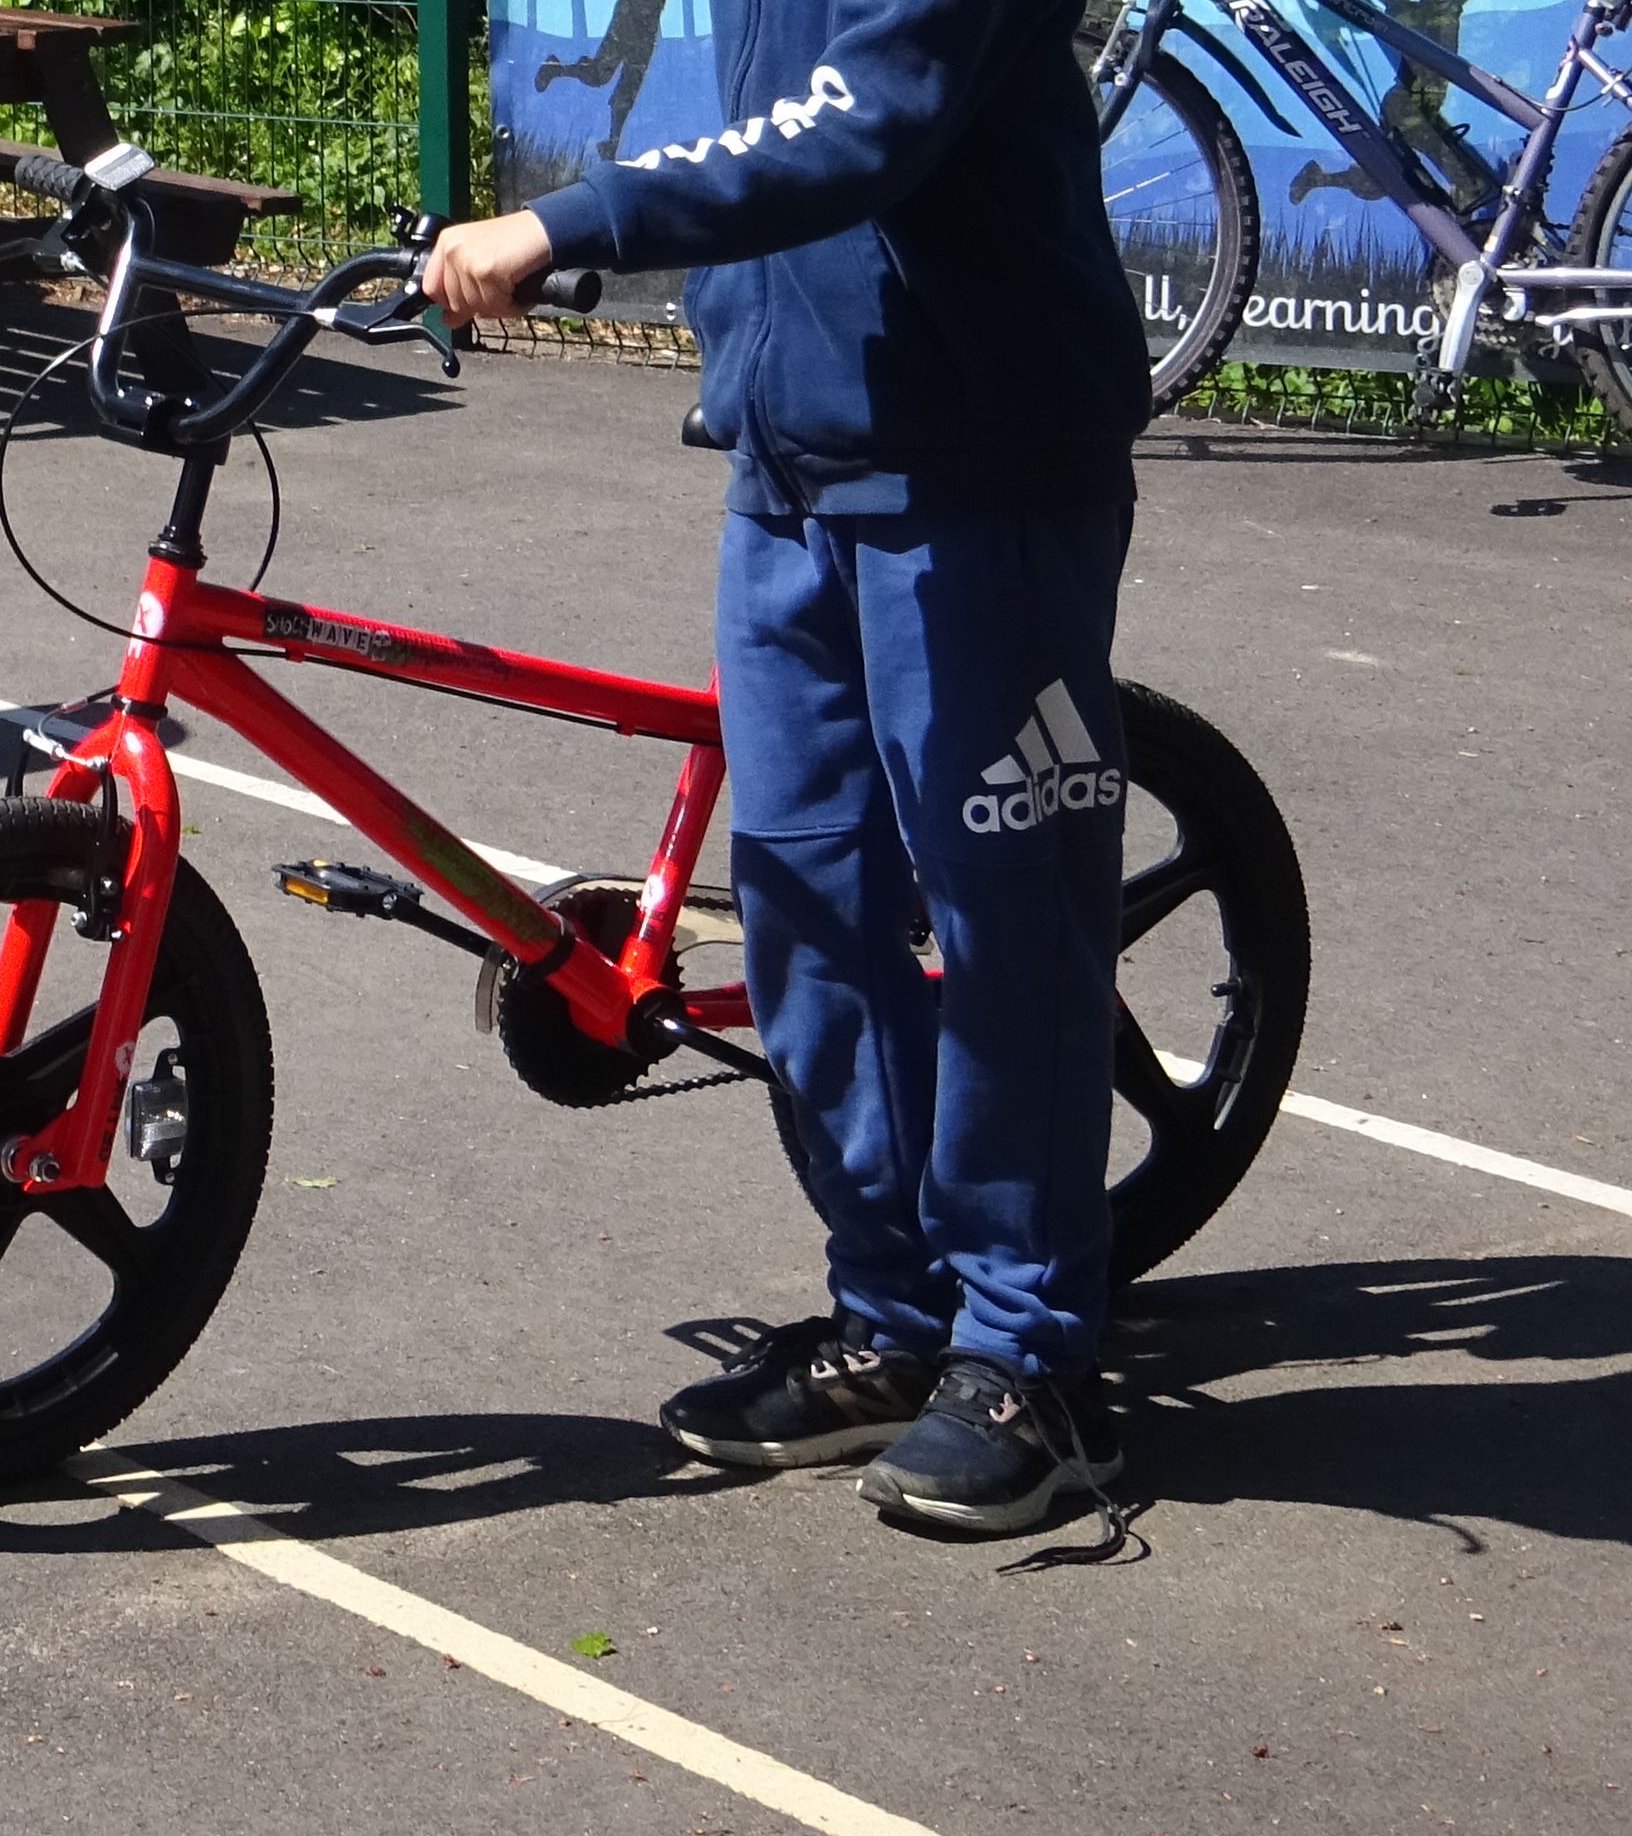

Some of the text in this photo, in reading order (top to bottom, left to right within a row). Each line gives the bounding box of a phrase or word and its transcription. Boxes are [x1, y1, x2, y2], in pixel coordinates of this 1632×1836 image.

[1144, 275, 1442, 354] ll, earning
[962, 764, 1122, 834] adidas
